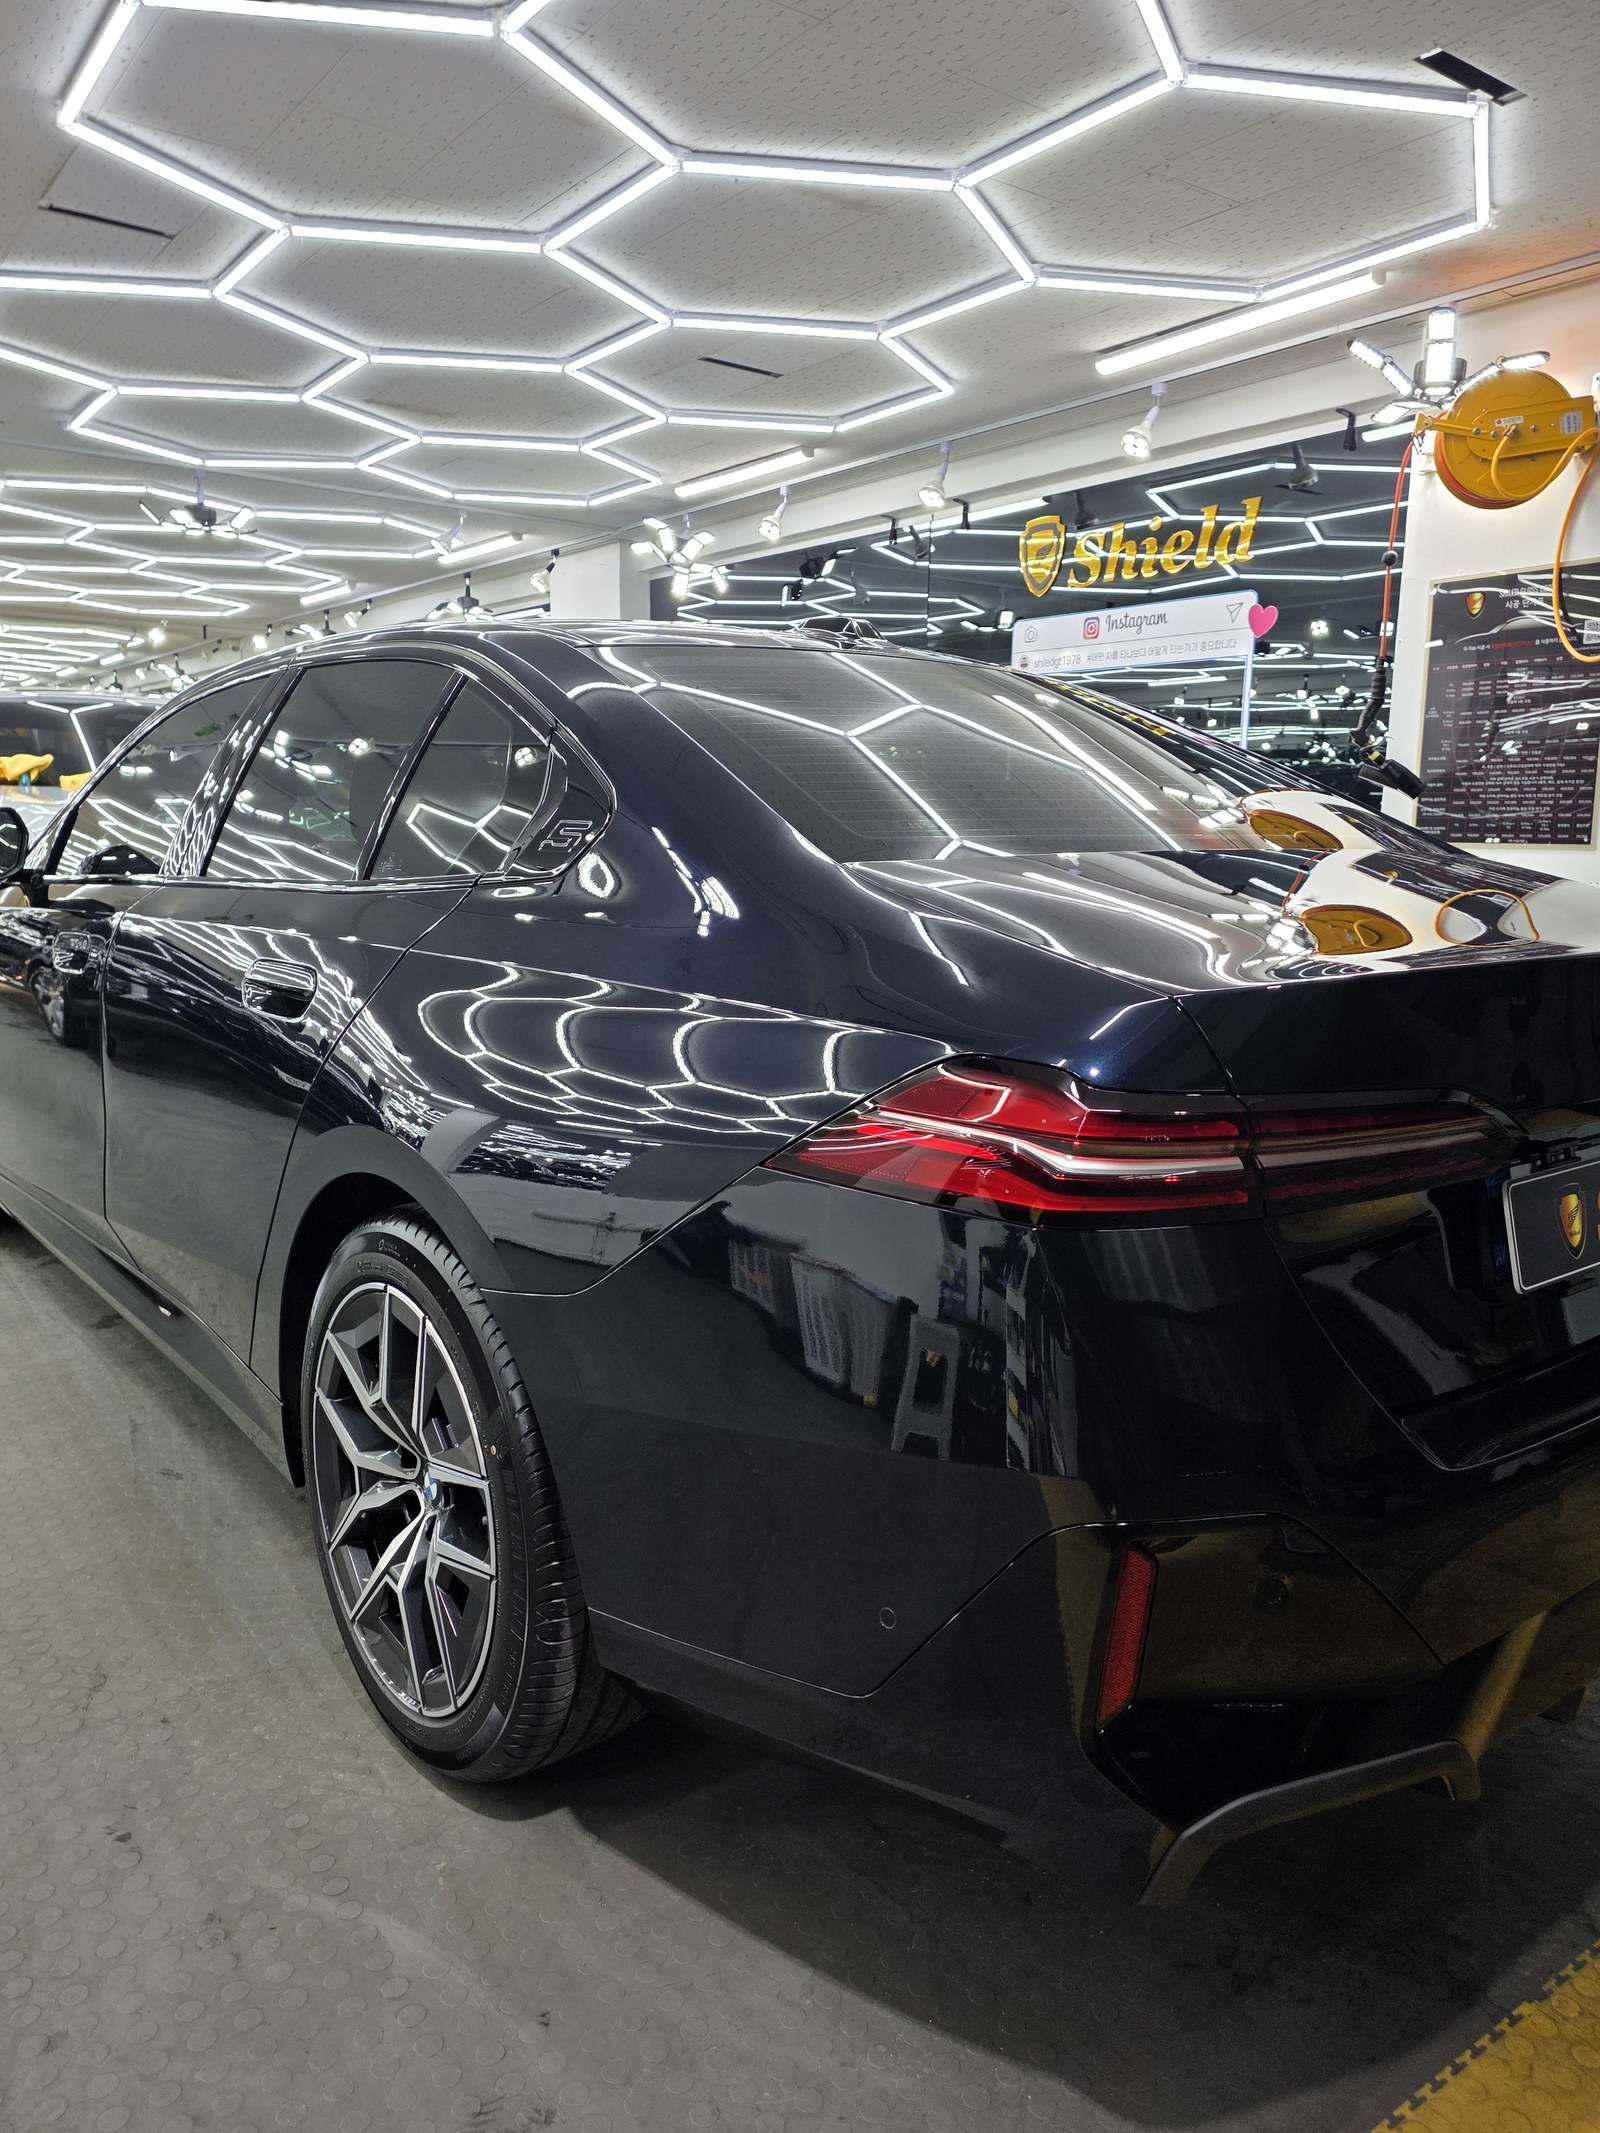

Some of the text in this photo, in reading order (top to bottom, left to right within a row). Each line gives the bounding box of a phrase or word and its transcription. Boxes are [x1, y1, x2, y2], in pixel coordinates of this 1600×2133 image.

[1067, 496, 1263, 588] Shield
[1505, 599, 1520, 609] 시공
[1105, 612, 1168, 635] Instagram
[1200, 638, 1237, 652] 중요합니다
